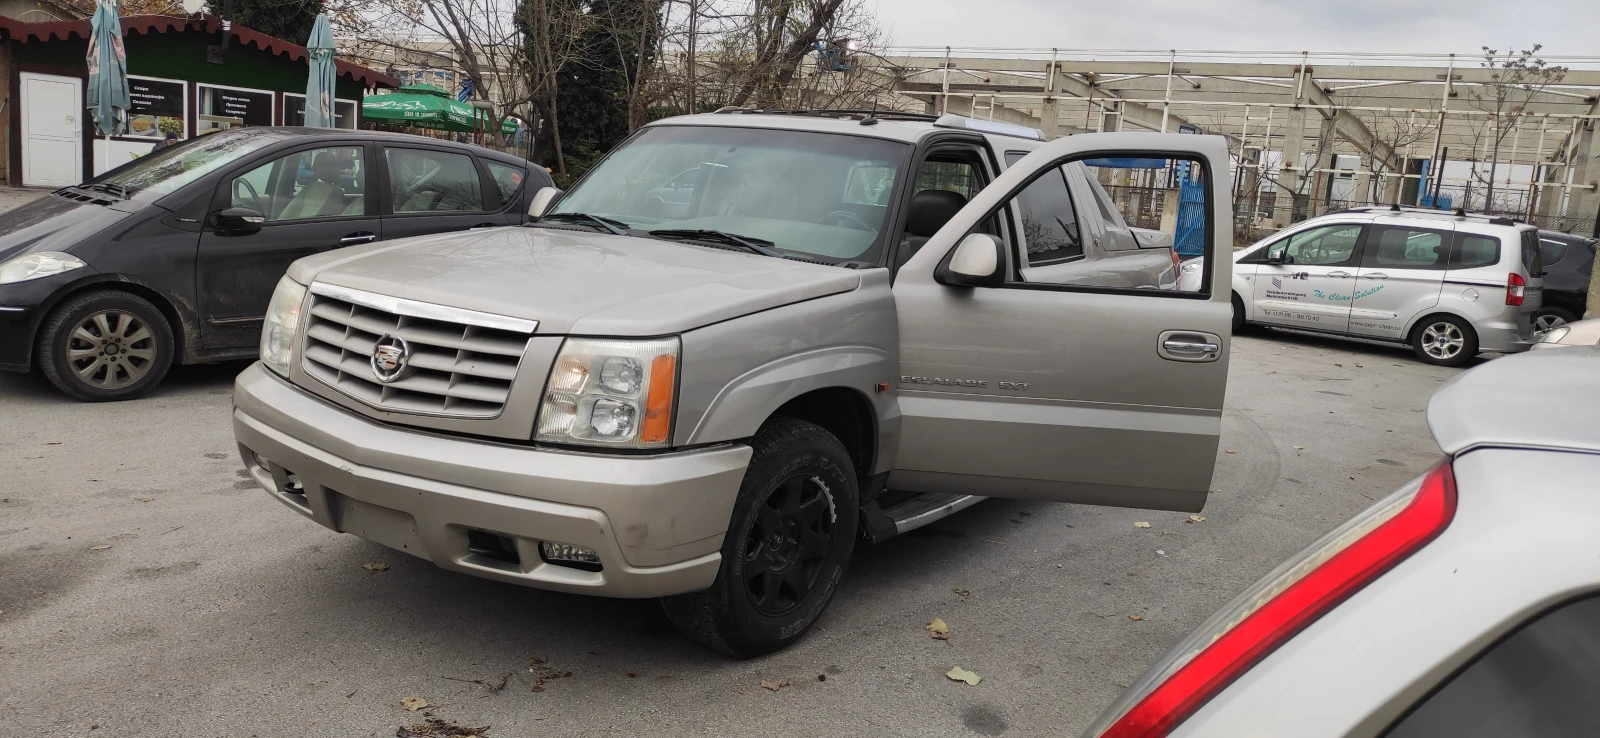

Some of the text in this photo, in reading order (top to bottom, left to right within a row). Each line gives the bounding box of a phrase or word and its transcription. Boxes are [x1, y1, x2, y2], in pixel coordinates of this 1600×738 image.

[1314, 283, 1385, 301] The Clean Solution
[900, 375, 1031, 391] ESCALADE EXT
